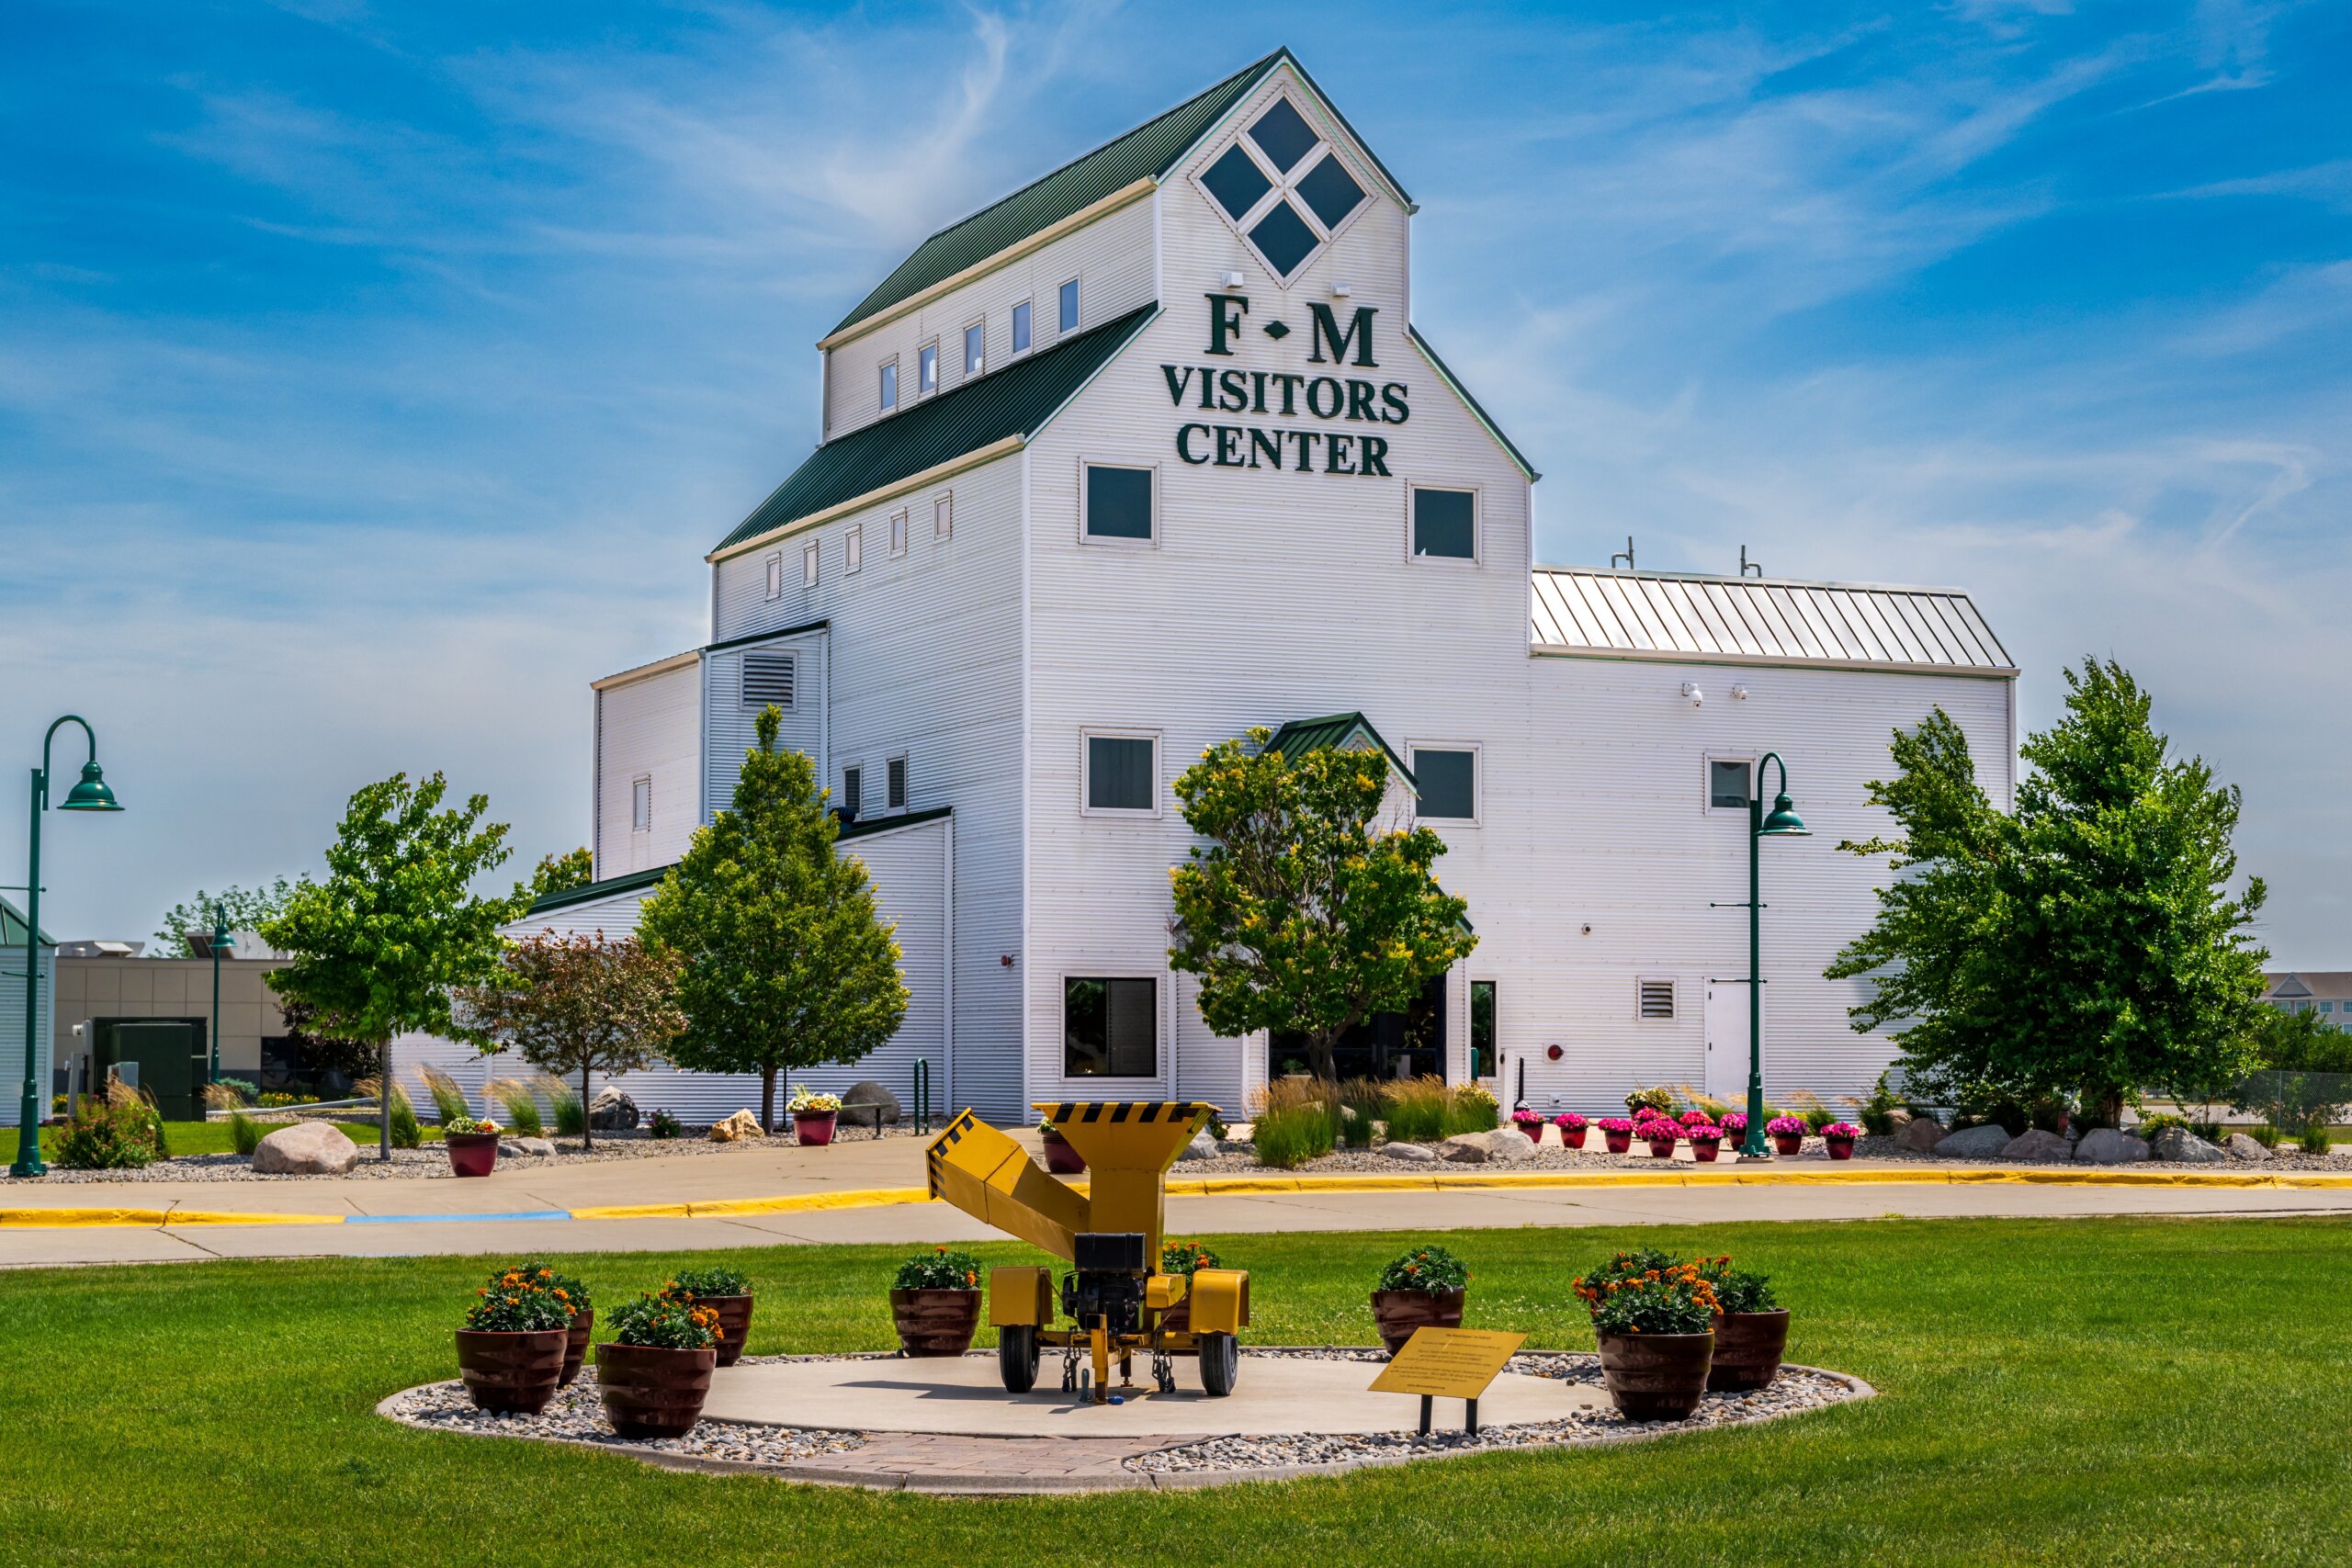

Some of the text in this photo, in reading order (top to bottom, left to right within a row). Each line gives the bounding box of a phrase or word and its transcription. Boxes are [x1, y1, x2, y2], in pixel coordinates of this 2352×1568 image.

[1204, 293, 1379, 367] F M
[1159, 364, 1409, 424] VISITORS
[1176, 423, 1393, 477] CENTER
